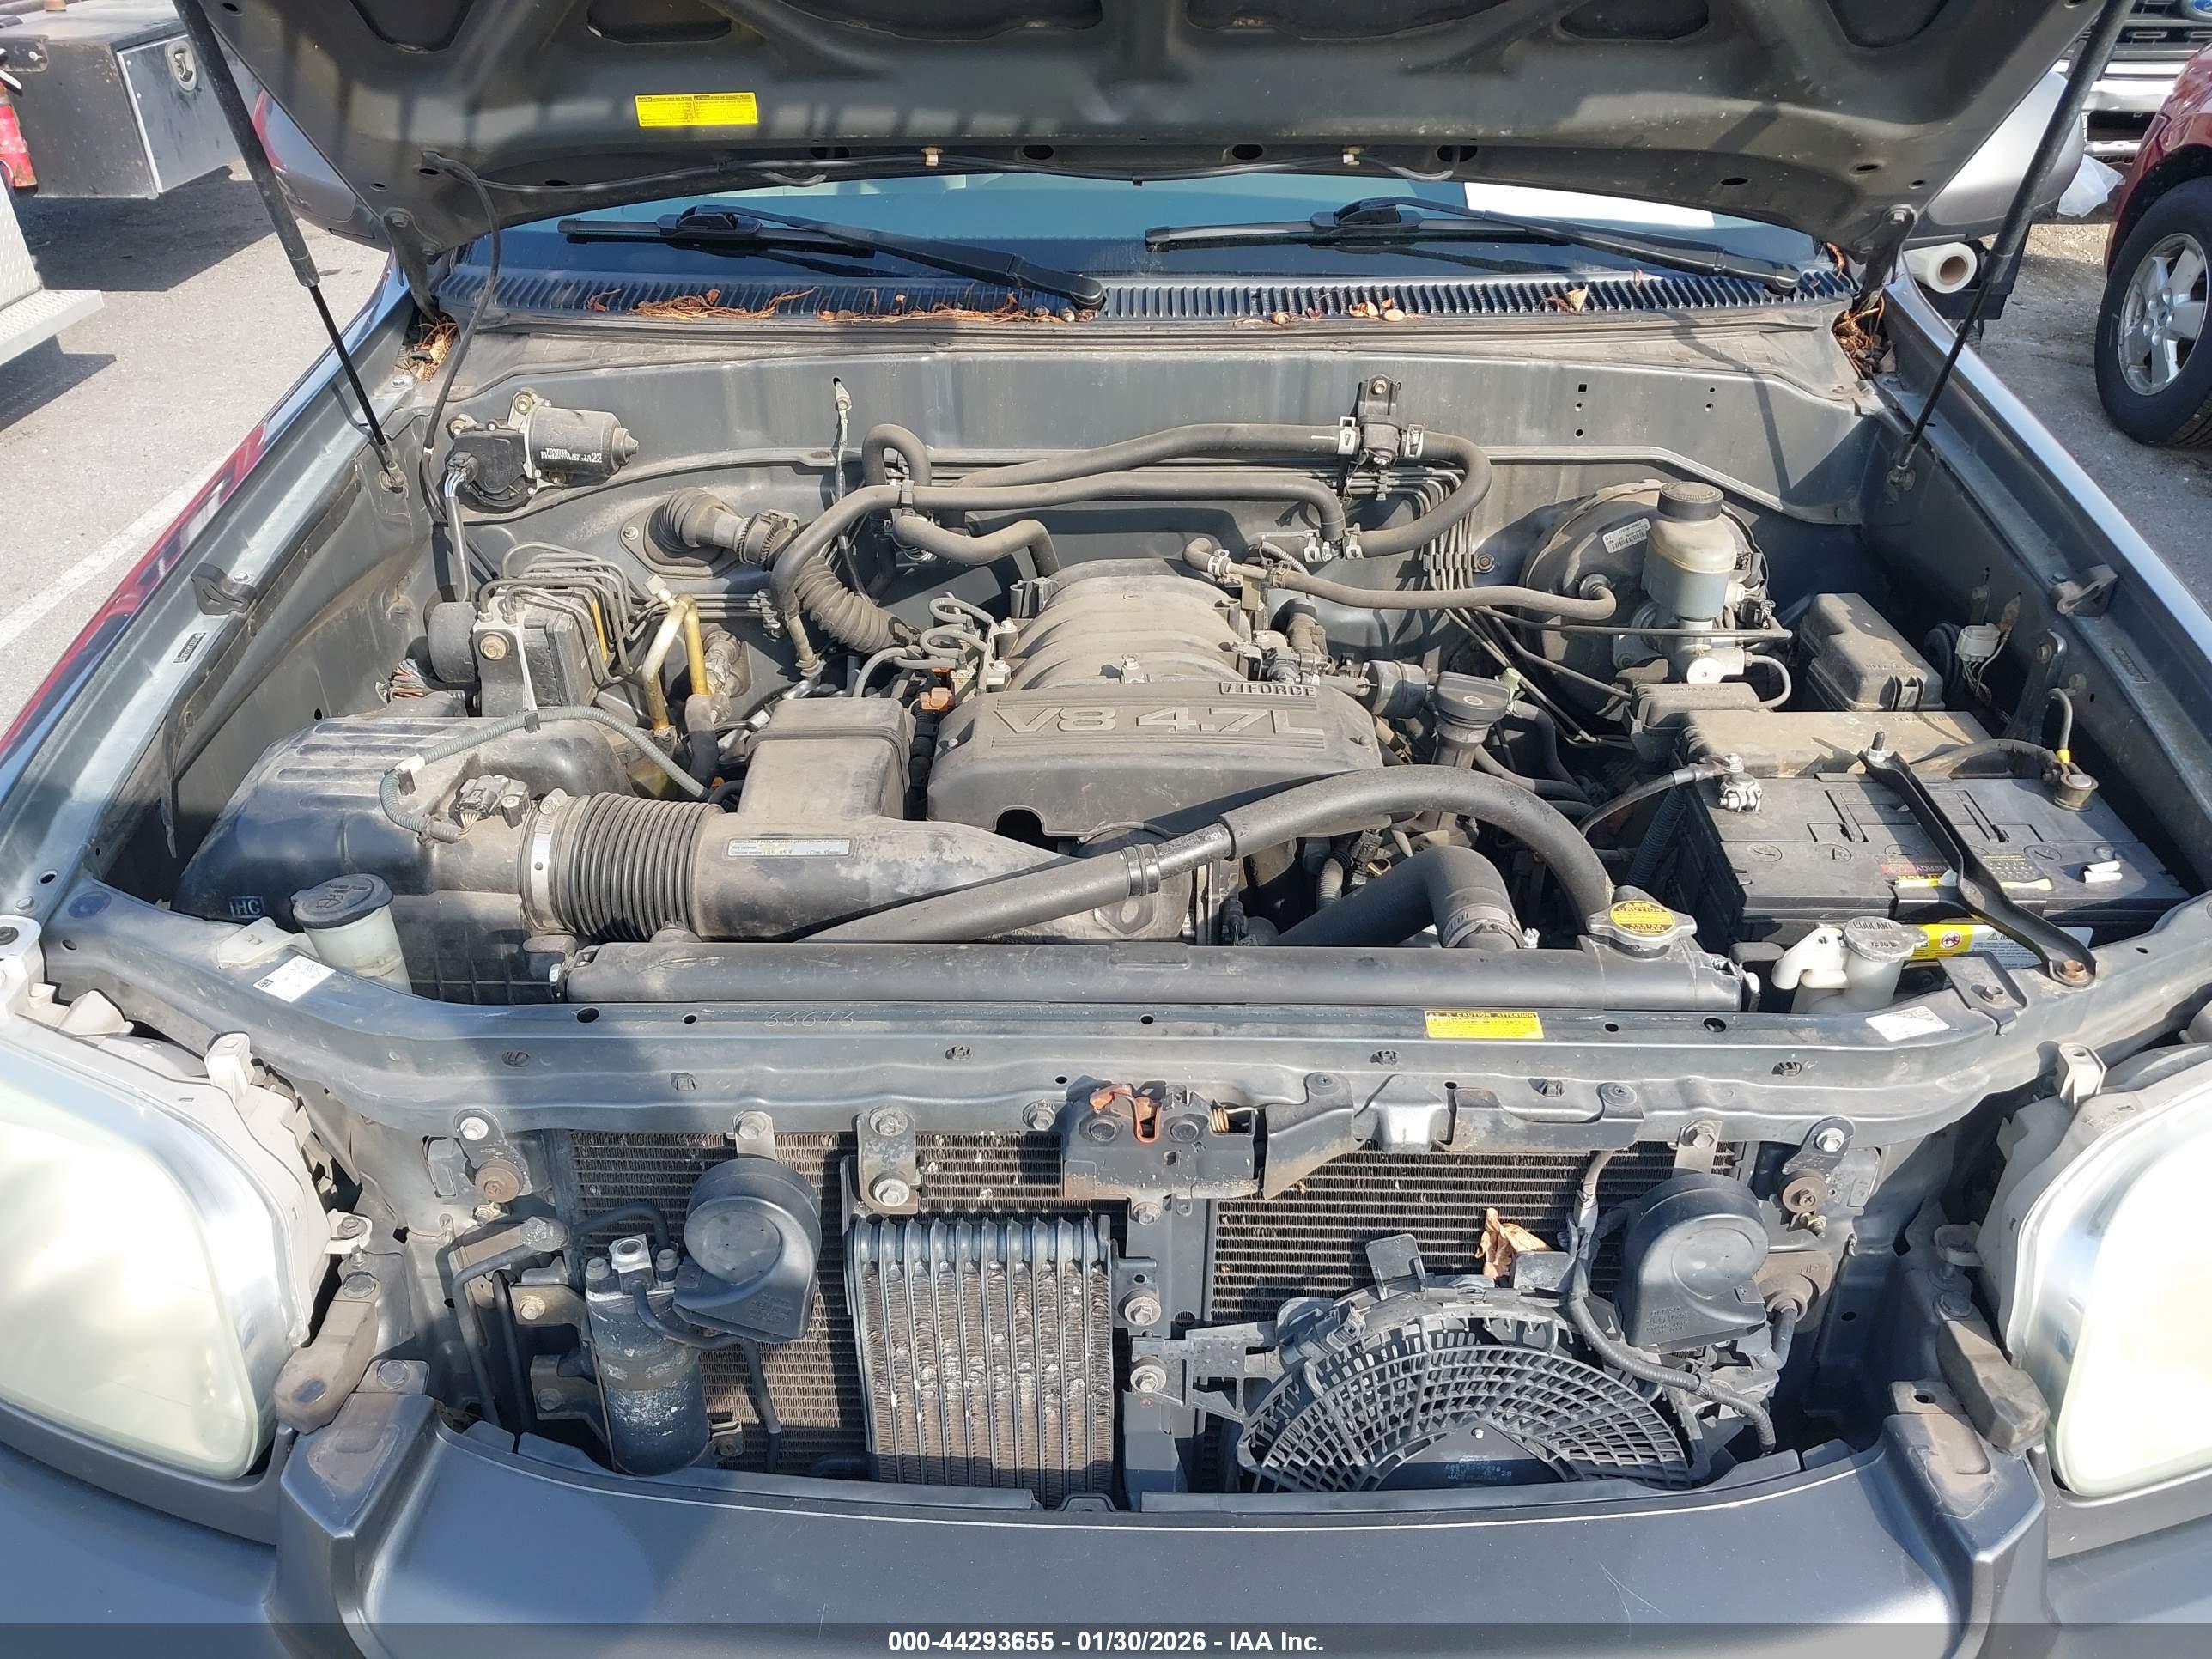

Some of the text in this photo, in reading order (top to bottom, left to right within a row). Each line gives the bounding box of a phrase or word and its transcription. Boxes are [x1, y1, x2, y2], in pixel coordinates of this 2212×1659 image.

[591, 452, 603, 463] 23
[994, 706, 1325, 736] V8 4.7L
[235, 898, 261, 915] HC
[763, 1010, 856, 1027] 33673
